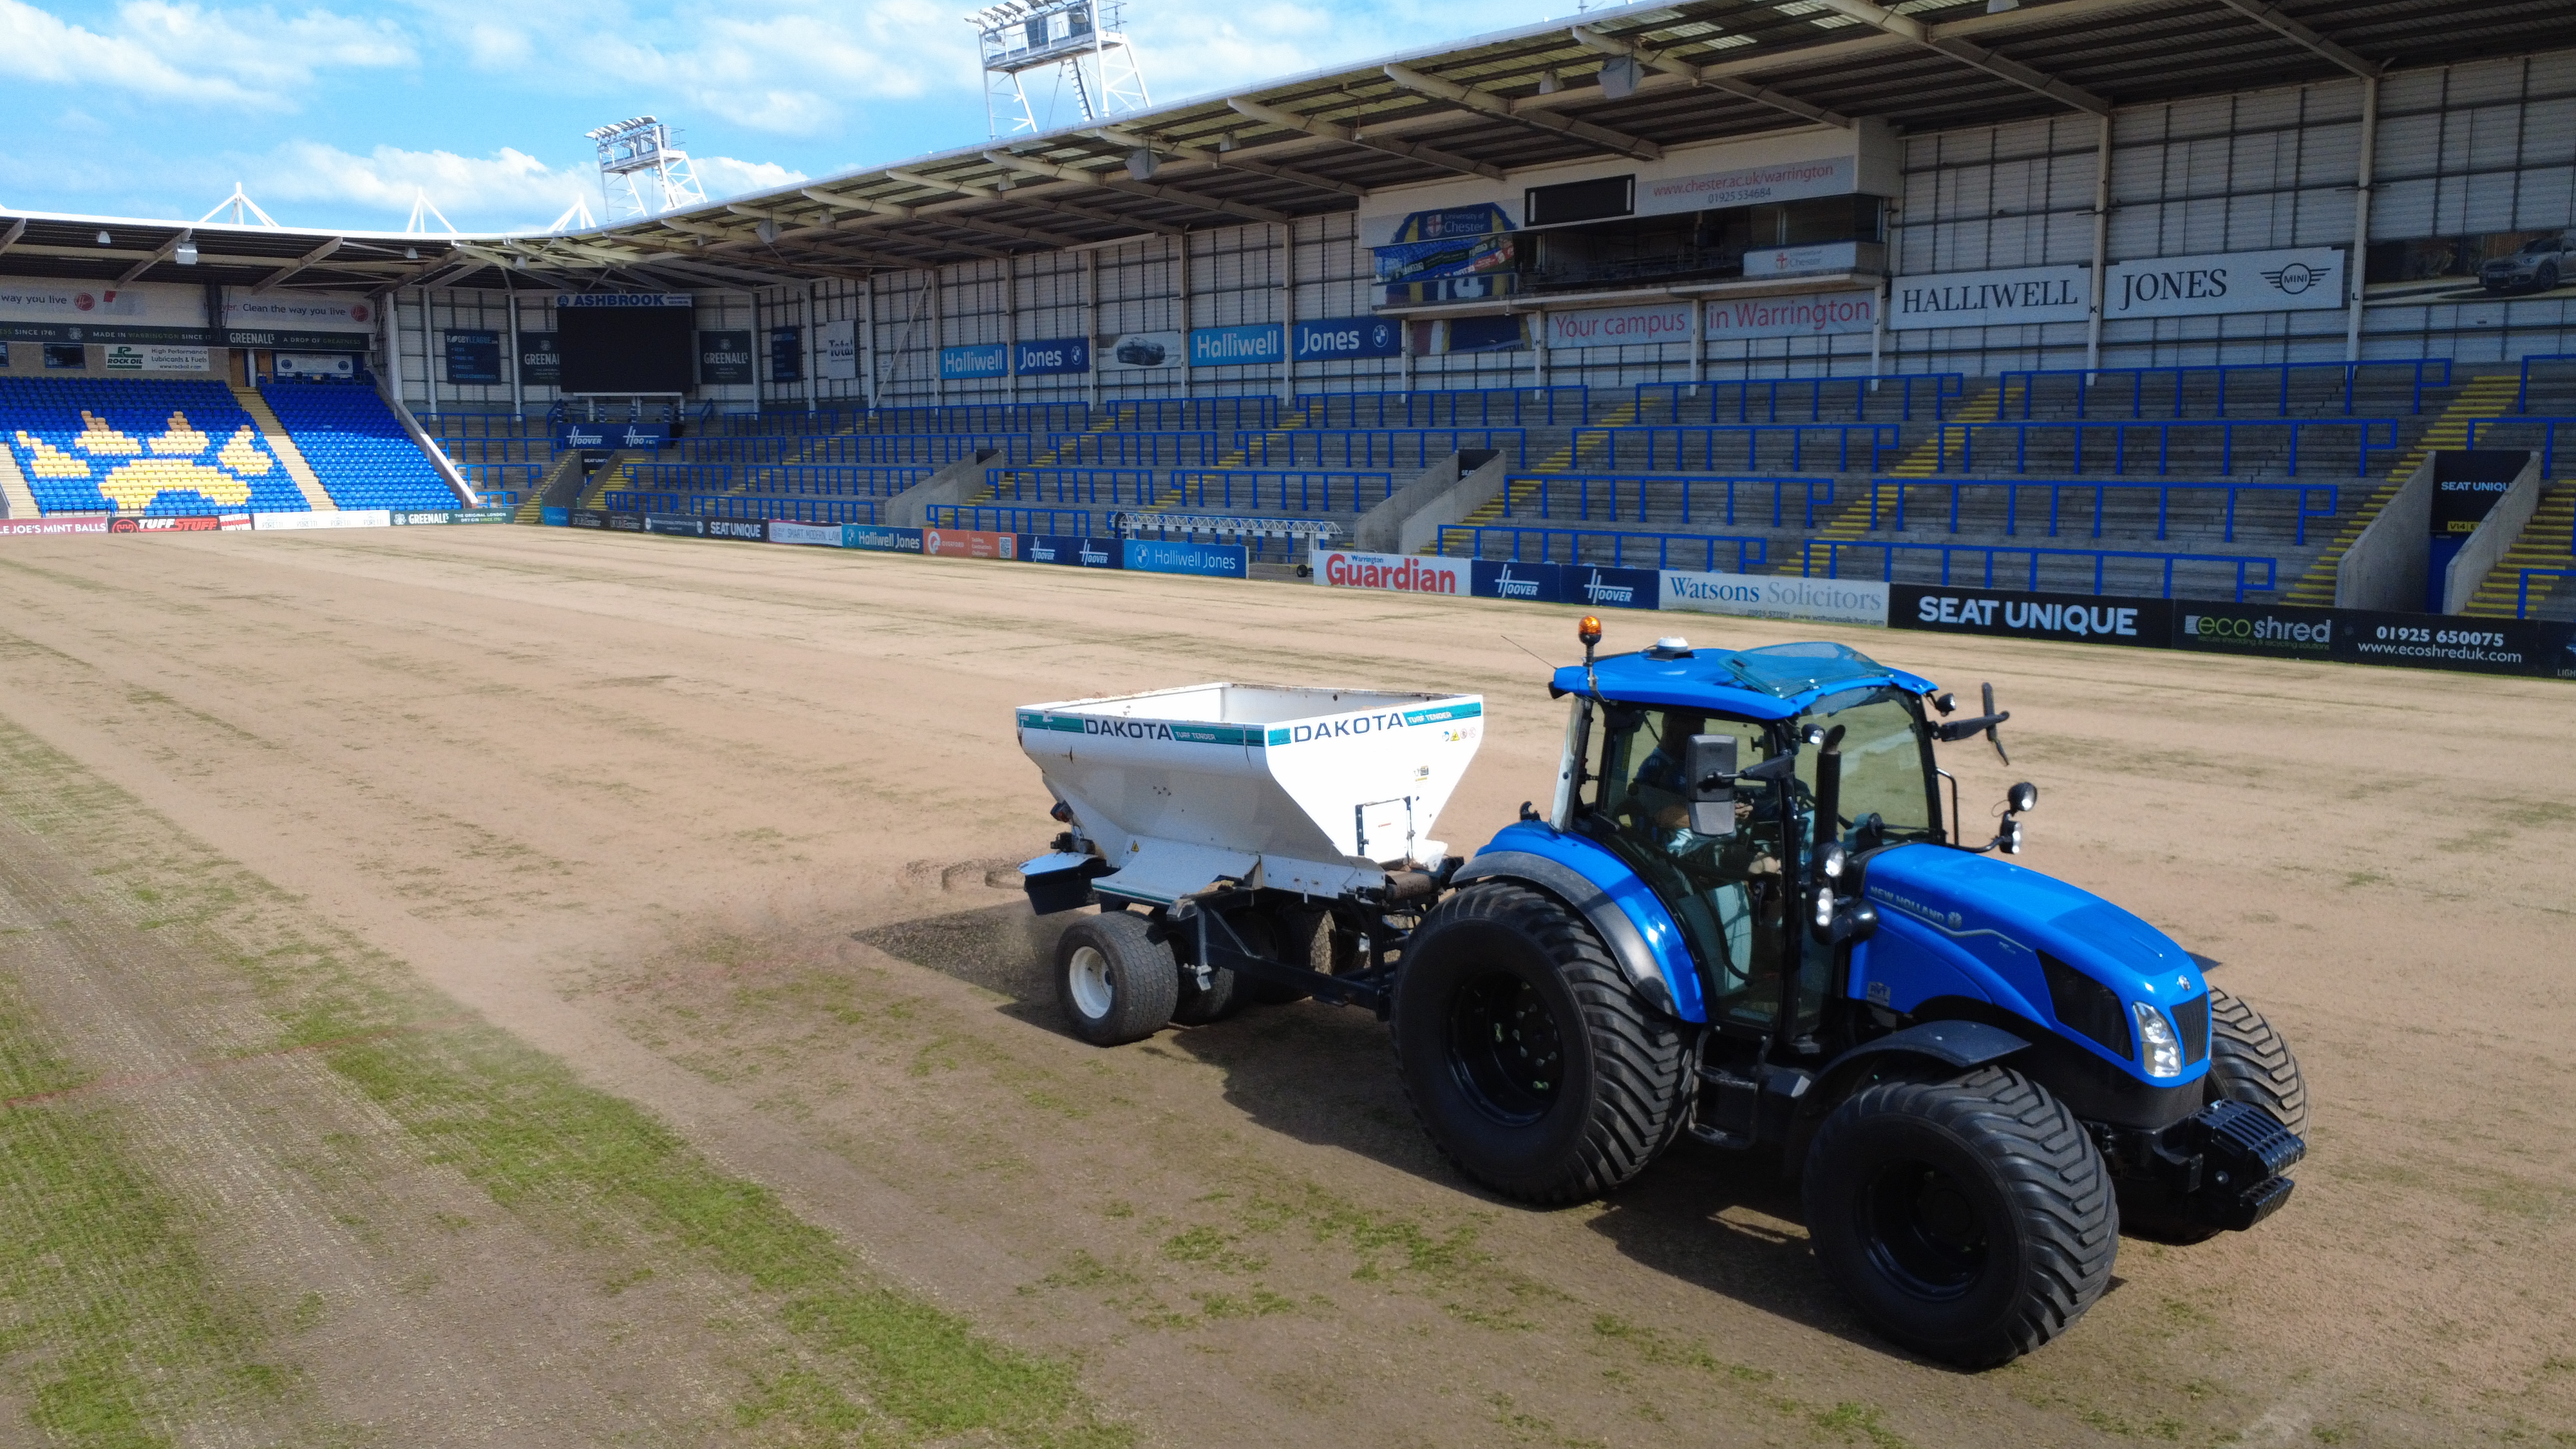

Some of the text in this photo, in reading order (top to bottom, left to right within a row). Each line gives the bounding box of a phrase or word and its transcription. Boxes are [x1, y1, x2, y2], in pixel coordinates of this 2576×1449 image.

[1444, 220, 1484, 234] Chester
[2119, 269, 2228, 311] JONES
[2284, 274, 2308, 284] MINI
[1, 294, 22, 304] way
[49, 296, 67, 304] live
[573, 294, 665, 306] ASHBROOK
[1902, 279, 2078, 313] HALLIWELL
[243, 303, 268, 312] Clean
[270, 305, 286, 313] the
[290, 307, 307, 315] way
[310, 307, 327, 316] you
[330, 307, 346, 316] live
[1709, 300, 1870, 330] in Warrington
[1555, 313, 1686, 339] Your campus
[1197, 330, 1278, 358] Halliwell
[1300, 327, 1360, 355] Jones
[945, 349, 1003, 373] Halliwell
[1019, 346, 1063, 370] Jones
[566, 426, 603, 448] HOOVER
[2441, 482, 2512, 492] SEAT UNIQU
[12, 524, 41, 534] JOE'S
[44, 524, 73, 533] MINT
[75, 522, 106, 533] BALLS
[710, 521, 729, 535] SEAT
[731, 522, 761, 538] UNIQUE
[858, 531, 920, 549] Halliwell Jones
[1030, 536, 1056, 562] HOOVER
[1079, 538, 1108, 566] HOOVER
[1155, 549, 1236, 570] Halliwell Jones
[1351, 554, 1384, 564] Warrington
[1325, 553, 1456, 594] Guardian
[1494, 564, 1539, 598] HOOVER
[1584, 568, 1634, 604] HOOVER
[1669, 576, 1881, 611] Watsons Solicitors
[1918, 595, 2138, 637] SEAT UNIQUE
[2376, 626, 2504, 647] 01925 650075
[2358, 642, 2522, 663] www.ecoshreduk.com
[1084, 719, 1173, 741] DAKOTA
[1192, 732, 1216, 741] TENDER
[1294, 711, 1452, 743] DAKOTA TURF TENDER
[1870, 885, 1946, 923] NEW HOLLAND
